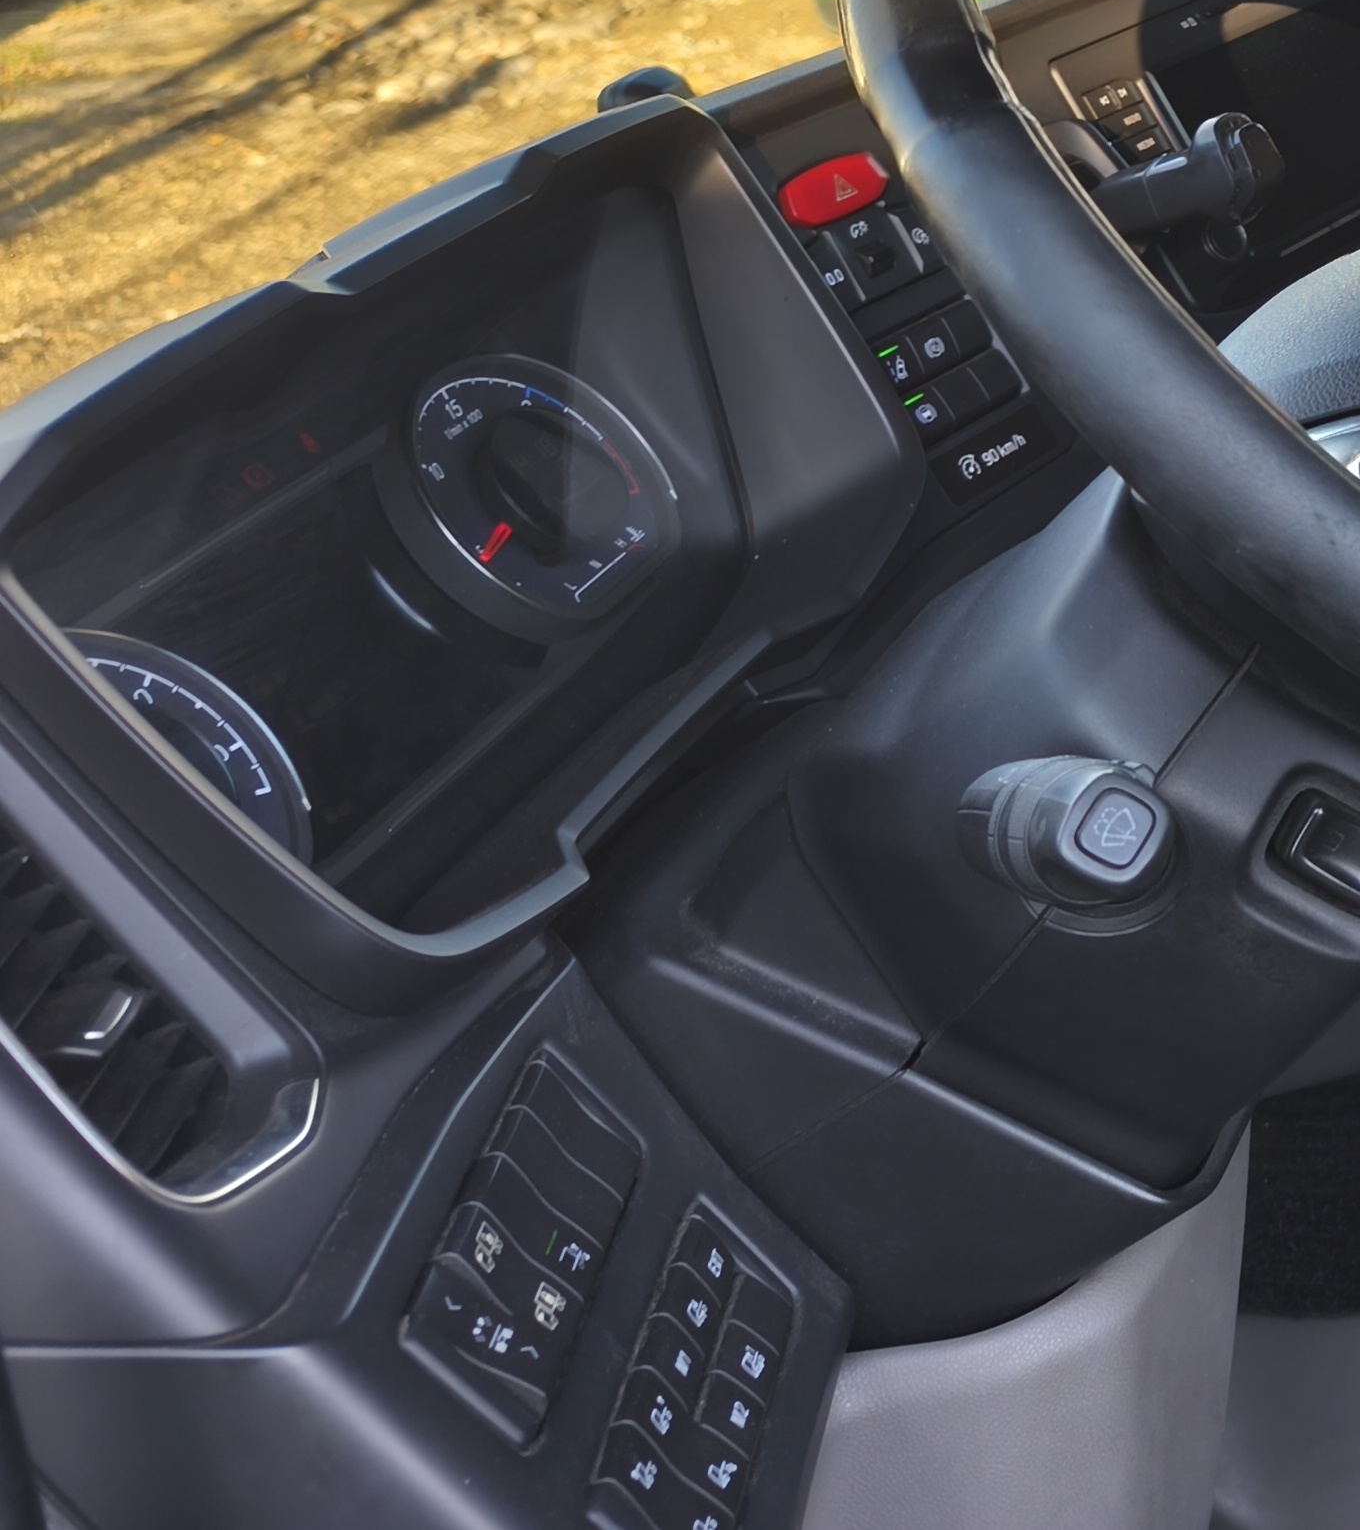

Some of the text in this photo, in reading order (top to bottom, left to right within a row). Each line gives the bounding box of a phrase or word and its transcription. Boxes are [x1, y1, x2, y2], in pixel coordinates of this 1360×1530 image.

[444, 398, 463, 420] 15
[981, 434, 1027, 466] 90 km/h
[428, 462, 445, 481] 10
